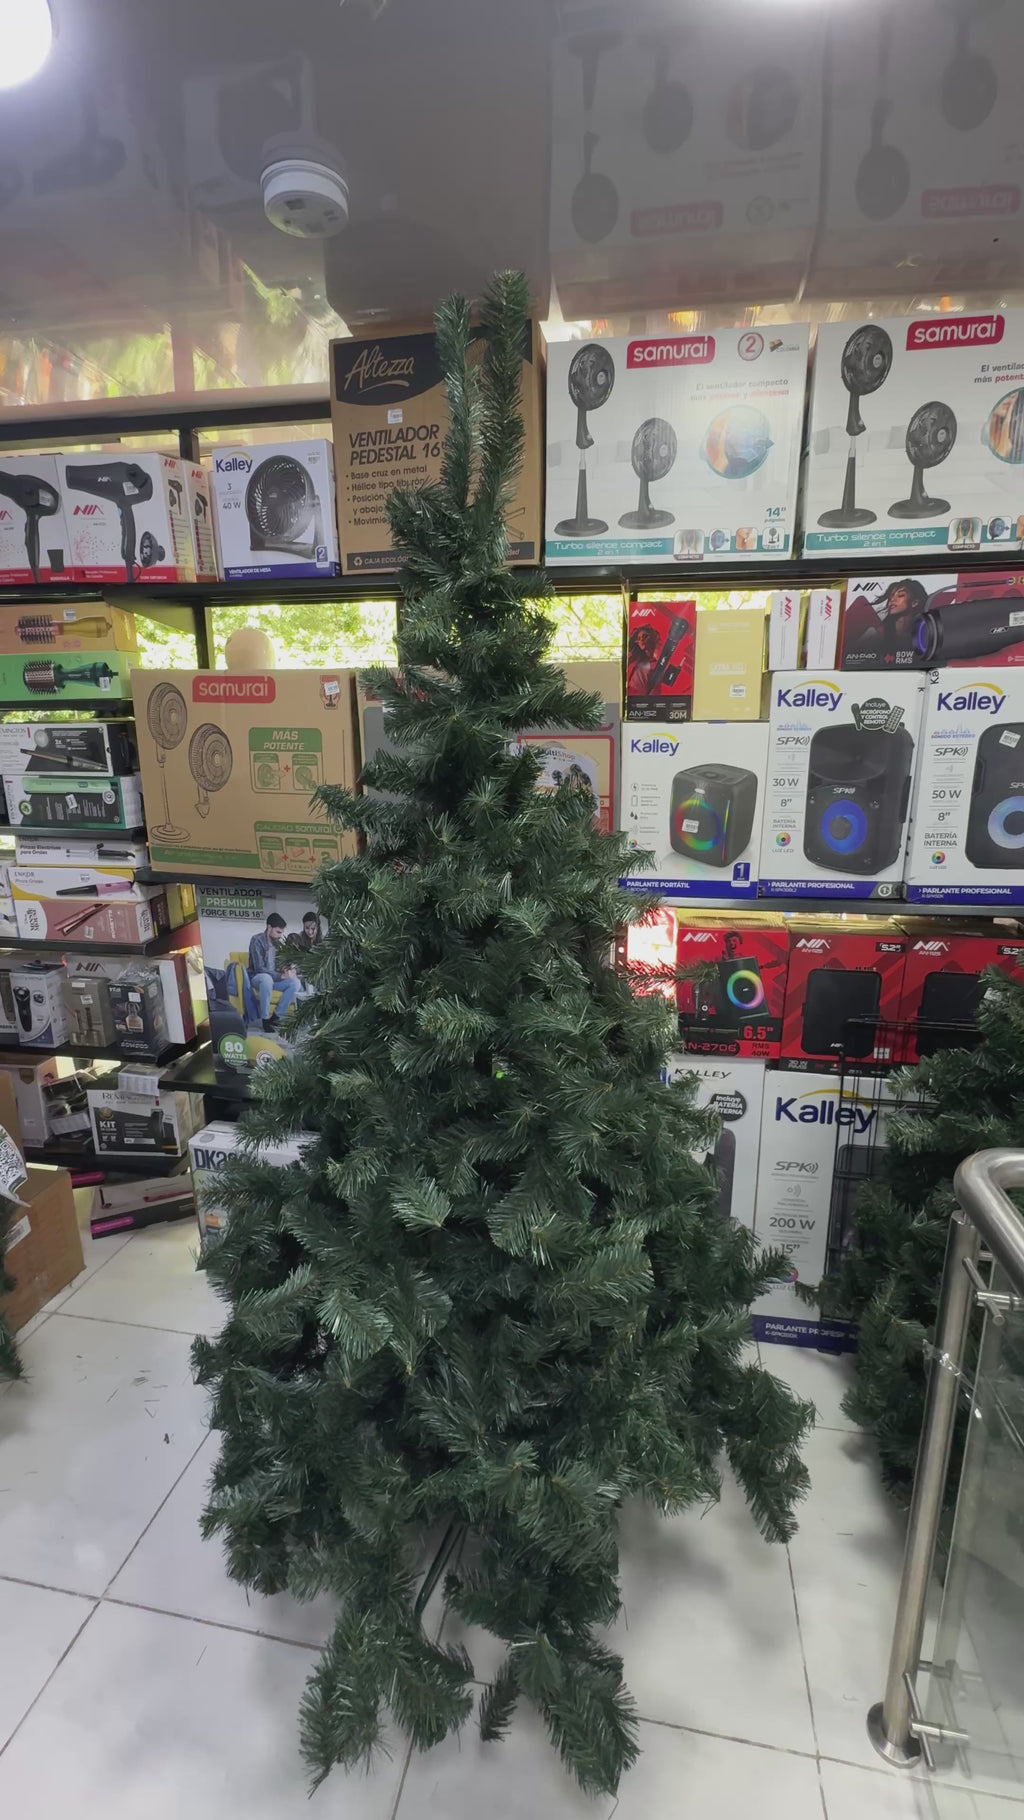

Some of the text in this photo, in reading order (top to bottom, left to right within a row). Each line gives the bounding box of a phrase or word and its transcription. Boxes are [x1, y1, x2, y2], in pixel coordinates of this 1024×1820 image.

[914, 316, 996, 343] samurai
[743, 334, 756, 353] 2
[633, 336, 708, 363] samurai
[344, 346, 414, 388] Altezza
[981, 364, 990, 373] El
[349, 424, 440, 448] VENTILADOR
[350, 445, 416, 466] PEDESTAL
[216, 457, 253, 473] Kalley
[351, 472, 369, 480] Base
[371, 470, 389, 478] cruz
[403, 465, 427, 475] metal
[351, 482, 377, 491] Hélice
[378, 480, 394, 489] tipo
[352, 493, 385, 503] Posición
[222, 502, 232, 510] 40
[353, 505, 383, 515] y abajo
[765, 507, 786, 518] 14"
[817, 530, 936, 542] Turbo silence compact
[554, 540, 663, 550] Turbo silence compact
[318, 548, 326, 559] 2
[852, 582, 883, 592] NIA
[199, 676, 269, 697] samurai
[777, 689, 843, 711] Kalley
[937, 691, 1006, 714] Kalley
[669, 711, 687, 720] 30M
[263, 742, 304, 750] POTENTE
[776, 736, 804, 746] SPK
[631, 739, 680, 757] Kalley
[934, 747, 962, 757] SPK
[772, 778, 799, 787] 30 W
[932, 789, 962, 799] 50 W
[295, 824, 332, 833] samurai
[924, 839, 957, 847] INTERNA
[737, 863, 745, 876] 1
[626, 880, 690, 889] PARLANTE PORTÁTIL
[807, 881, 855, 889] PROFESIONAL
[200, 887, 263, 897] VENTILADOR
[206, 898, 257, 908] PREMIUM
[201, 908, 227, 917] FORCE
[229, 909, 250, 917] PLUS
[682, 932, 717, 943] NIA
[795, 938, 831, 949] NIA
[912, 940, 949, 951] NIA
[743, 1025, 774, 1040] 6.5"
[225, 1041, 243, 1053] 80
[224, 1052, 247, 1060] WATTS
[716, 1095, 741, 1104] Incluye
[775, 1096, 877, 1133] Kalley
[99, 1120, 116, 1128] KIT
[774, 1160, 810, 1173] SPK
[769, 1217, 815, 1230] 200 W
[765, 1322, 807, 1334] PARLANTE
